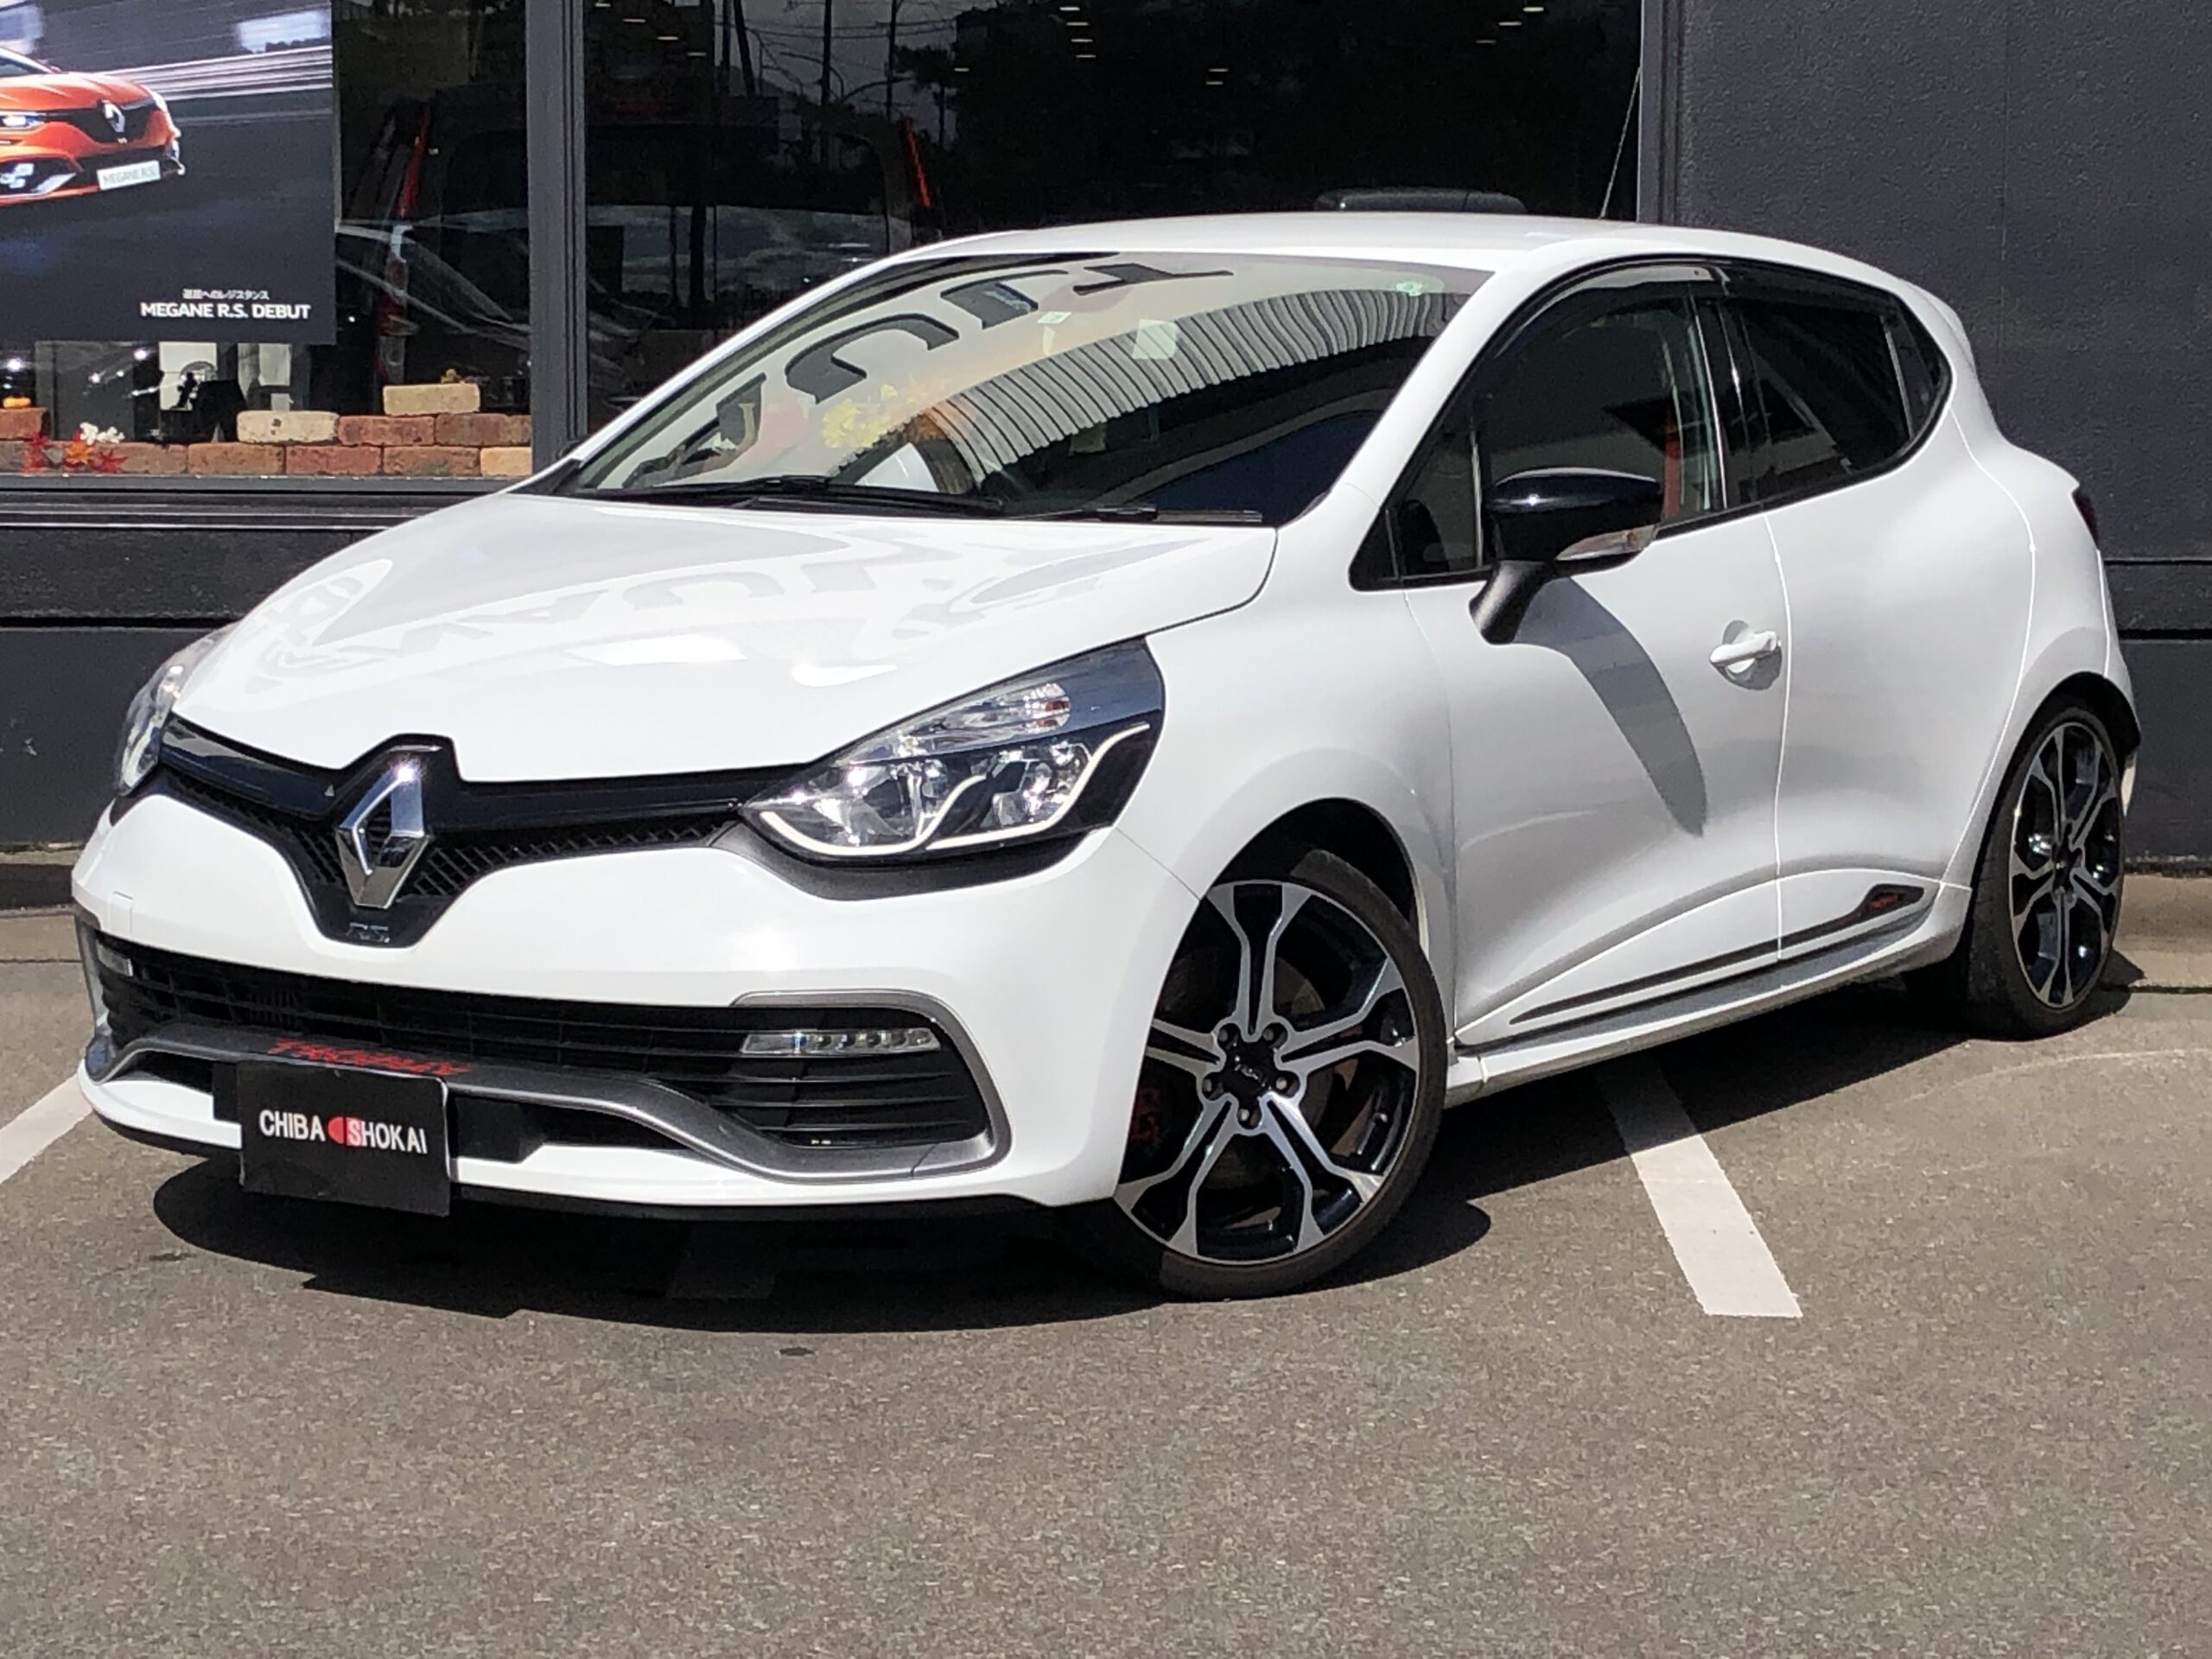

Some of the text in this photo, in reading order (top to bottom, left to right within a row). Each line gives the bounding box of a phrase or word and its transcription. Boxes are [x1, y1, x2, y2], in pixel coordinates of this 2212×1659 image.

[140, 302, 311, 320] MEGANE R.S. DEBUT
[259, 1109, 428, 1154] CHIBA SHOKAI
